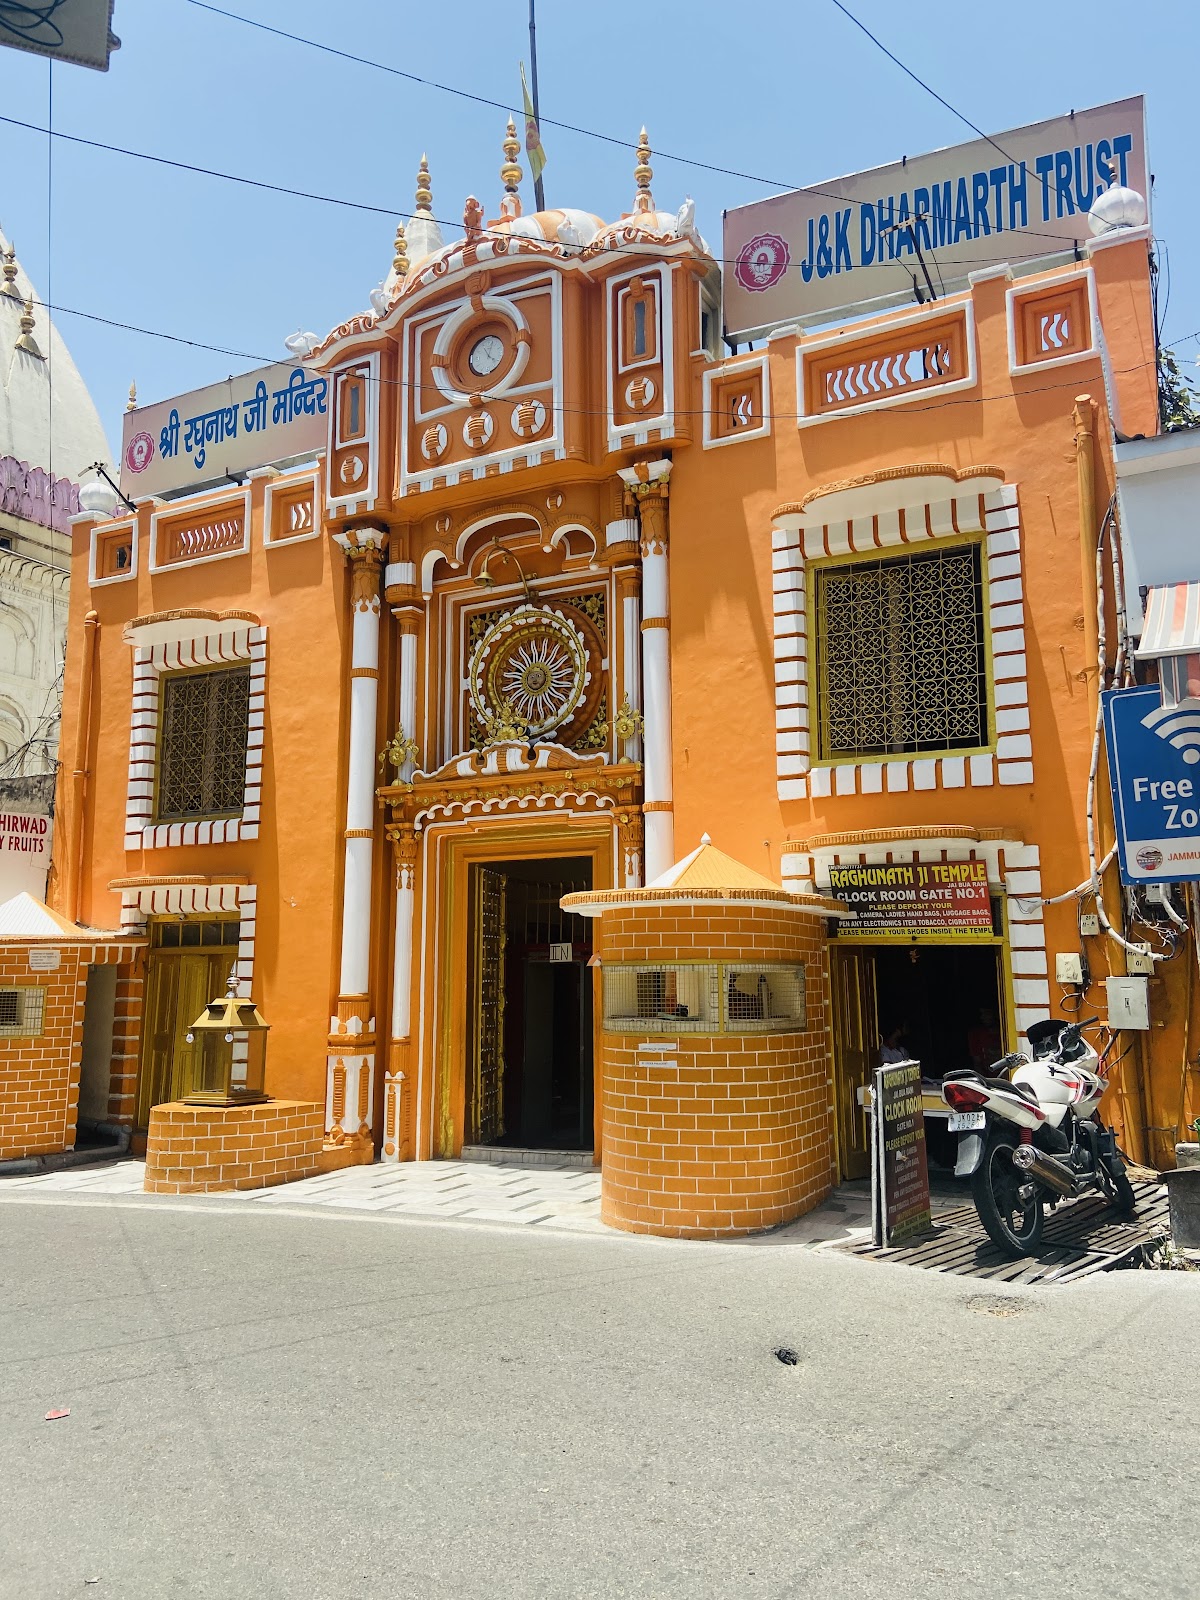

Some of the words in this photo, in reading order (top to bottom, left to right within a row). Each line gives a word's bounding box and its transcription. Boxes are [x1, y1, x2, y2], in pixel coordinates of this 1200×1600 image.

[801, 208, 852, 283] J&K
[861, 161, 1027, 268] DHARMARTH
[1036, 134, 1132, 222] TRUST
[159, 409, 180, 459] श्री
[184, 403, 239, 469] रघुनाथ
[243, 380, 268, 432] जी
[272, 369, 327, 424] मन्दिर
[1133, 778, 1193, 801] Free
[1163, 805, 1200, 829] Zo
[8, 836, 43, 852] FRUITS
[830, 867, 914, 888] RAGHUNATH
[917, 867, 928, 887] JI
[932, 864, 986, 883] TEMPLE
[837, 891, 877, 902] CLOCK
[880, 890, 916, 902] ROOM
[920, 889, 953, 900] GATE
[956, 888, 985, 899] NO.1
[550, 945, 568, 960] IN
[885, 1099, 905, 1121] CLOCK
[906, 1094, 922, 1115] ROOM
[886, 1137, 900, 1151] PLEASE
[900, 1132, 914, 1146] DEPOSIT
